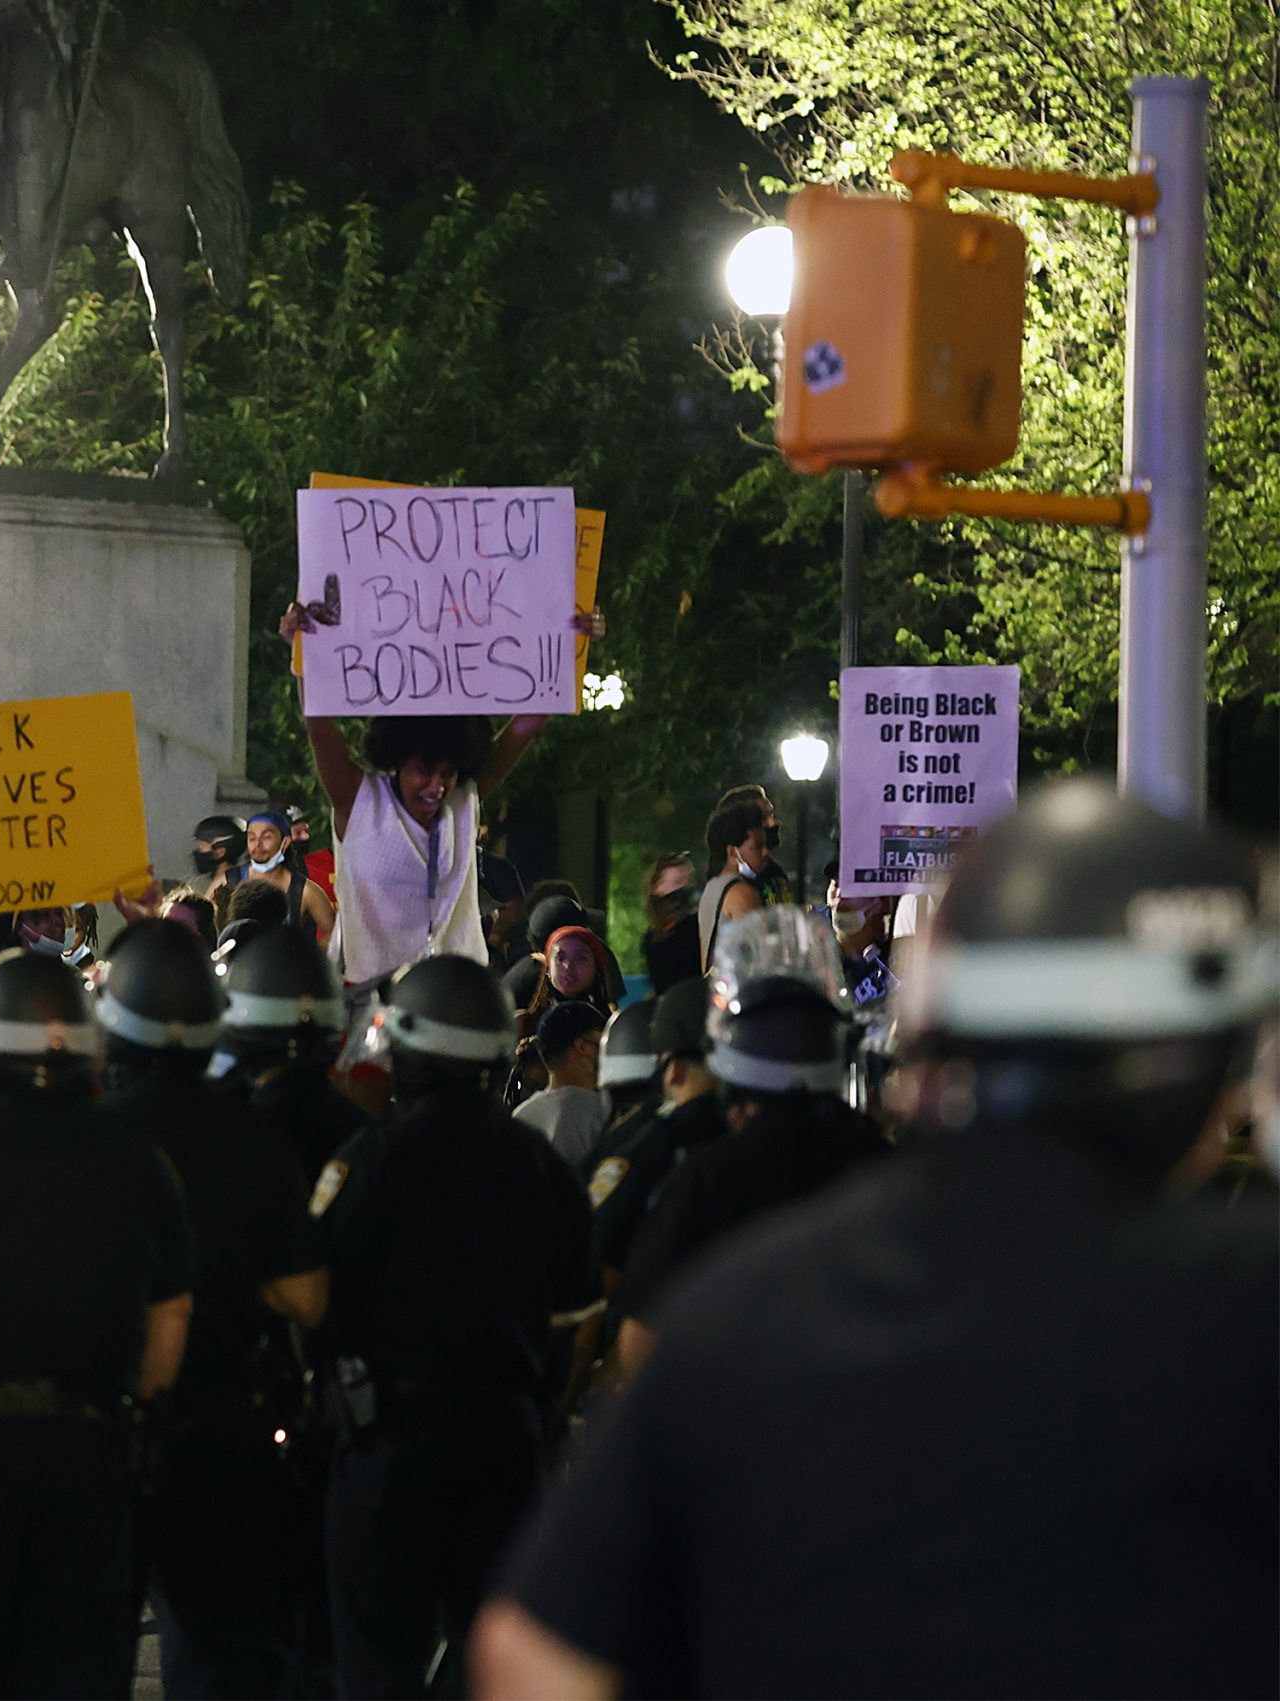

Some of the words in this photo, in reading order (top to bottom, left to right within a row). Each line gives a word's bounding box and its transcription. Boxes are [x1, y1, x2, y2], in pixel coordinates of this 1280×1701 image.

[335, 496, 555, 563] PROTECT
[360, 567, 521, 640] BLACK
[334, 632, 561, 706] BODIES!!!
[864, 693, 929, 718] Being
[935, 693, 997, 716] Black
[880, 724, 904, 742] or
[909, 720, 980, 743] Brown
[898, 751, 918, 773] is
[924, 752, 961, 773] not
[883, 784, 896, 803] a
[902, 782, 976, 804] crime!
[886, 851, 962, 868] FLATBUS
